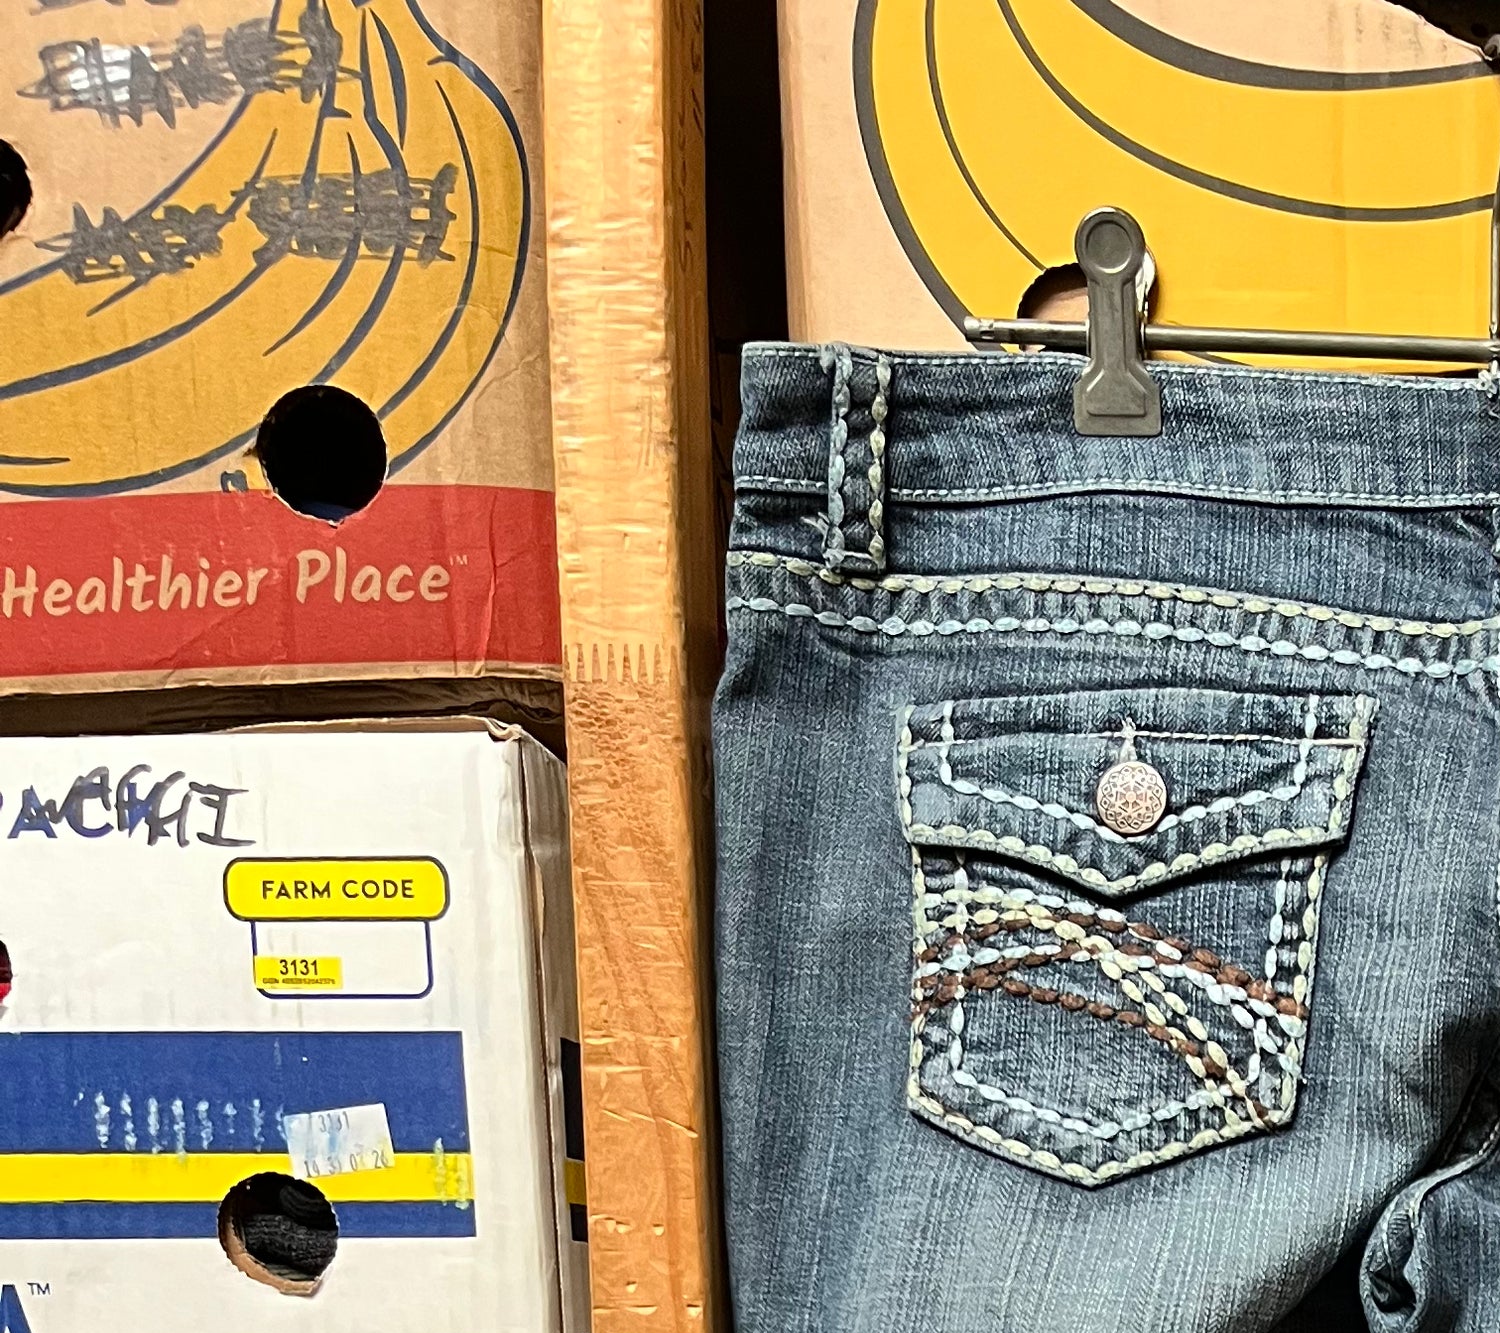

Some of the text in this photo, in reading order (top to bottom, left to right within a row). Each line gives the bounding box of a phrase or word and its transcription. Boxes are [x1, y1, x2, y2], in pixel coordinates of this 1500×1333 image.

[2, 548, 451, 618] Healthier Place
[262, 879, 416, 899] FARM CODE
[279, 959, 318, 976] 3131
